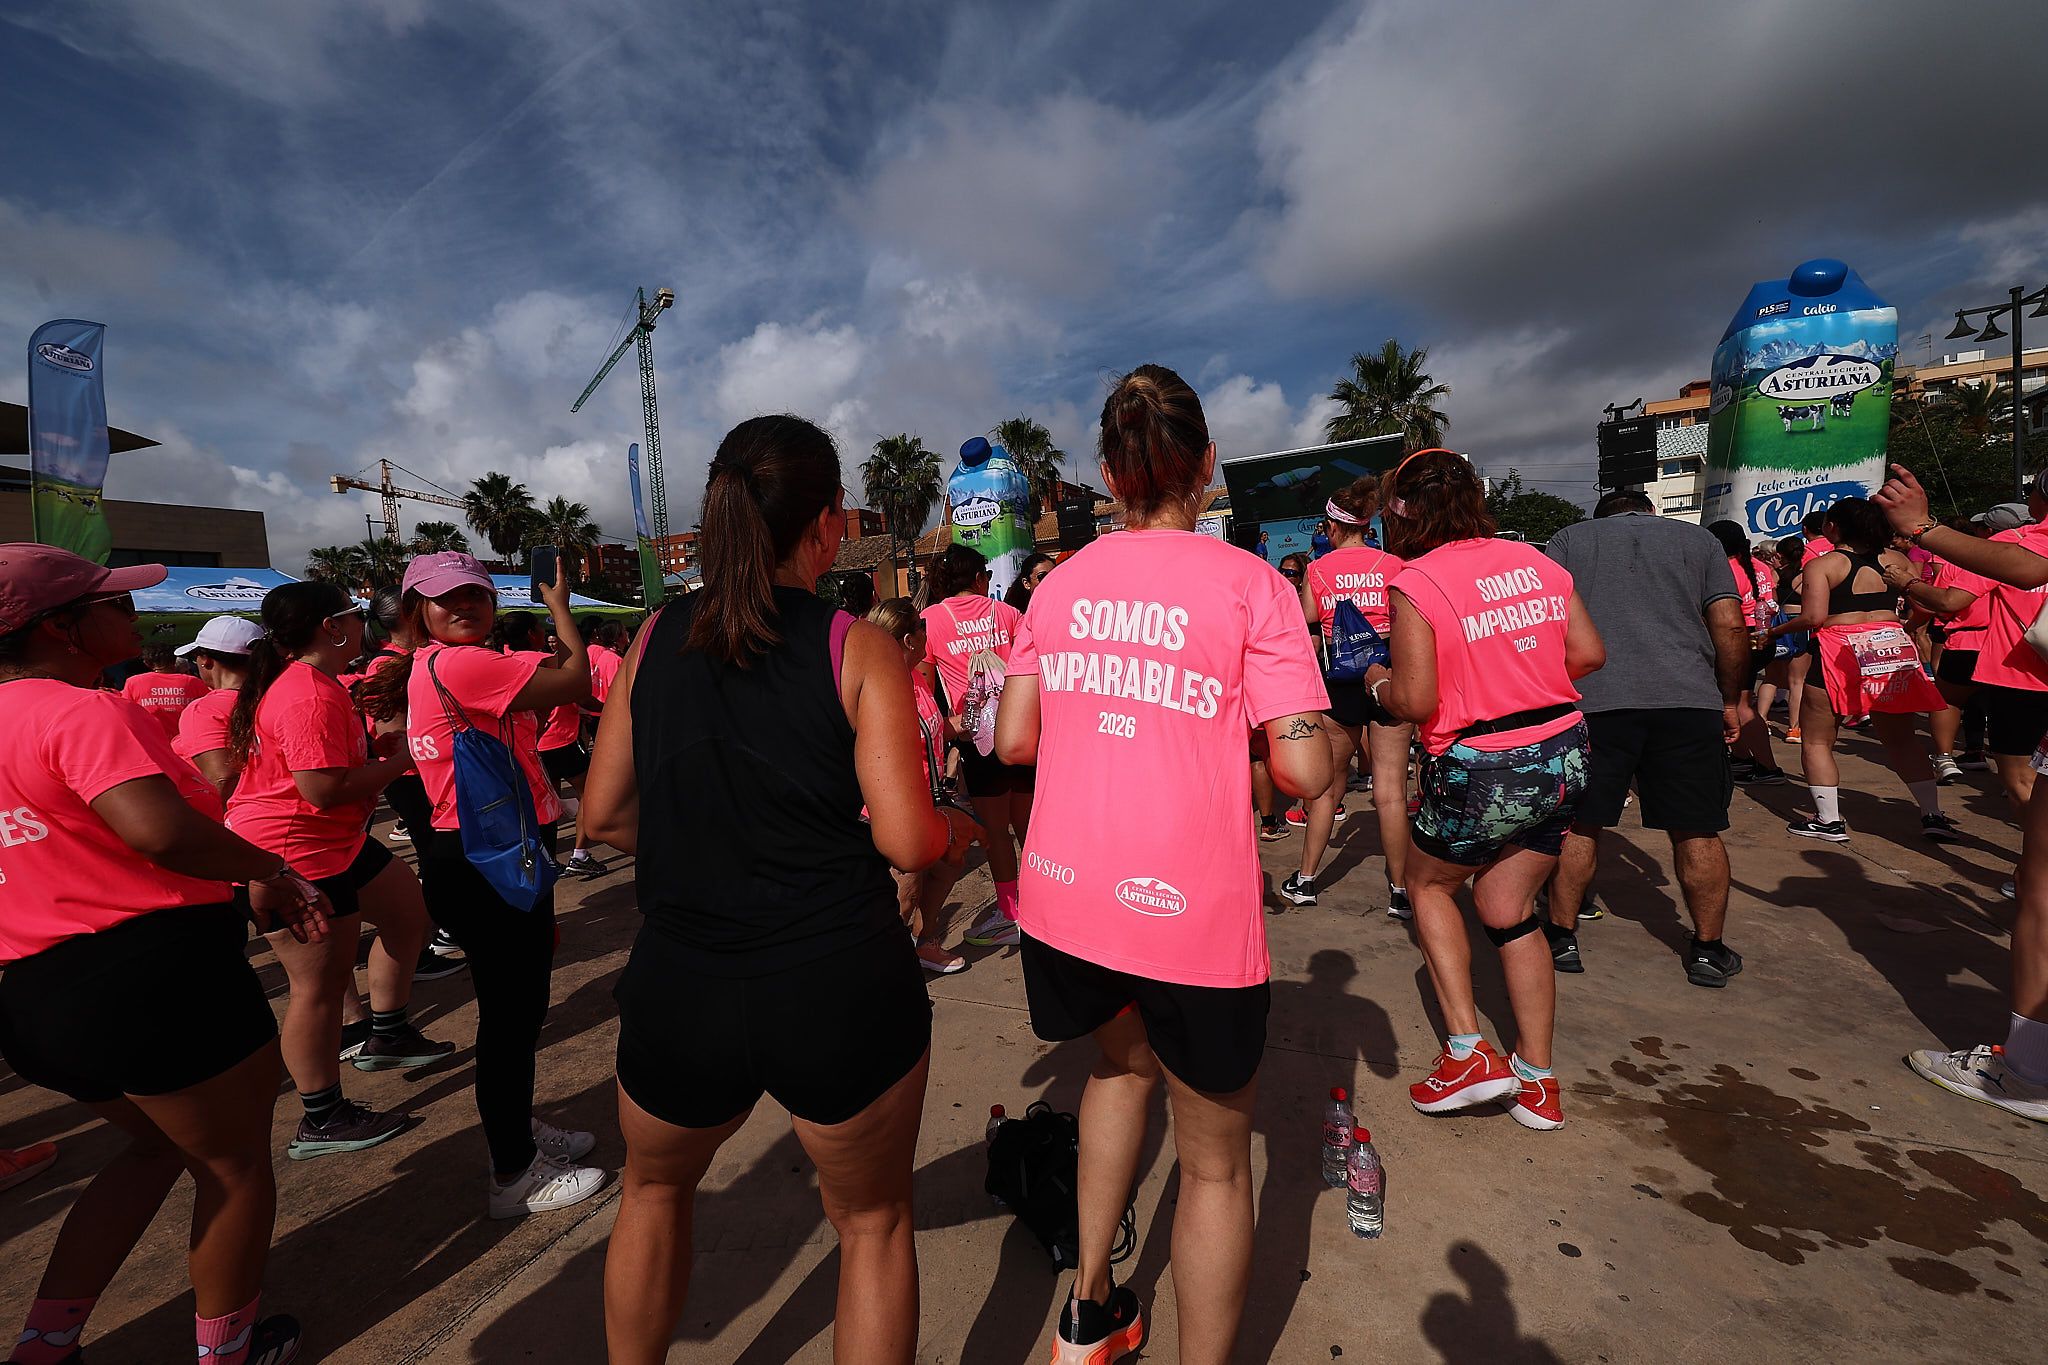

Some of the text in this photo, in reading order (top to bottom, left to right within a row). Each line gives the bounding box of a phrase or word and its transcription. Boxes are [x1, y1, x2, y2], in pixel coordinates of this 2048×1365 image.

[1759, 304, 1775, 316] PLS
[1803, 303, 1837, 316] calcio
[1765, 372, 1873, 394] ASTURIANA
[1785, 365, 1870, 379] CENTRAL LECHERA
[1755, 473, 1829, 496] Leche rica en
[954, 507, 997, 522] ASTURIANA
[1755, 492, 1854, 533] Calci
[1336, 573, 1384, 589] SOMOS
[1475, 566, 1543, 603] SOMOS
[955, 616, 997, 636] SOMOS
[1069, 598, 1189, 651] SOMOS
[151, 687, 185, 696] SOMOS
[1098, 711, 1136, 739] 2026
[1028, 852, 1075, 885] OYSHO
[1120, 885, 1181, 912] ASTURIANA
